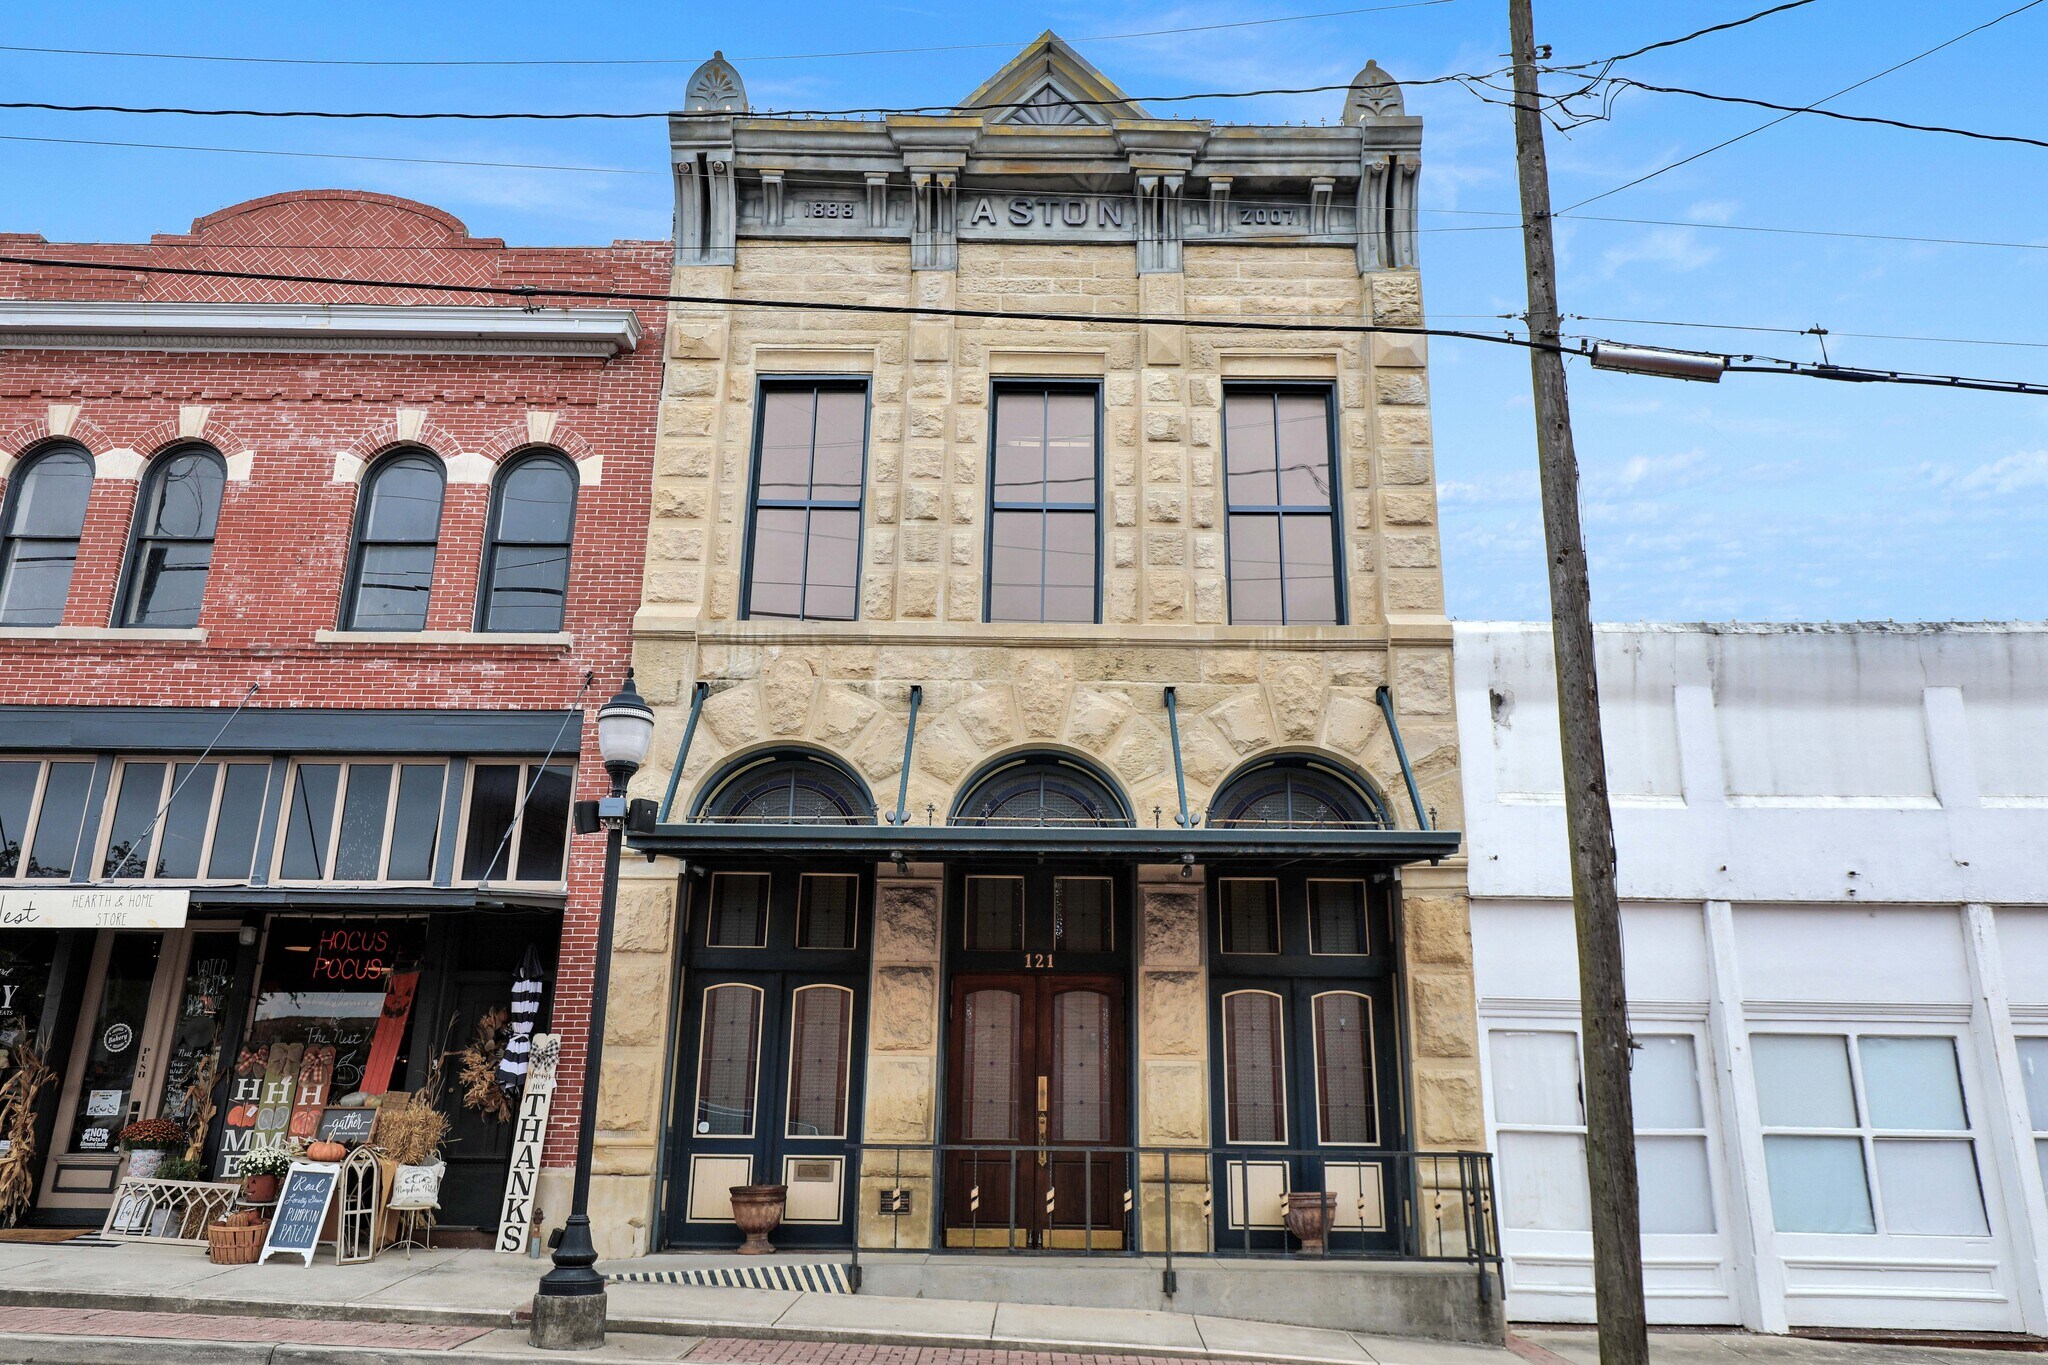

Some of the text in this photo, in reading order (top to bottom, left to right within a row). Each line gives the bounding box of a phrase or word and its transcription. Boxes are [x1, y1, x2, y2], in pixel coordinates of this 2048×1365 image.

[805, 202, 854, 219] 1888
[971, 197, 1124, 227] ASTON
[1240, 208, 1295, 225] 2007
[0, 895, 40, 924] est
[71, 895, 155, 908] HEARTH & HOME
[95, 912, 129, 926] STORE
[320, 930, 390, 952] HOCUS
[197, 958, 228, 976] VOTED
[312, 957, 384, 980] POCUS
[1025, 953, 1054, 968] 121
[137, 1047, 151, 1079] PUSH
[90, 1127, 103, 1138] NO
[321, 1111, 373, 1140] gather
[501, 1093, 546, 1252] THANKS
[285, 1207, 320, 1223] PUMPKIN
[278, 1223, 313, 1243] PATCH
